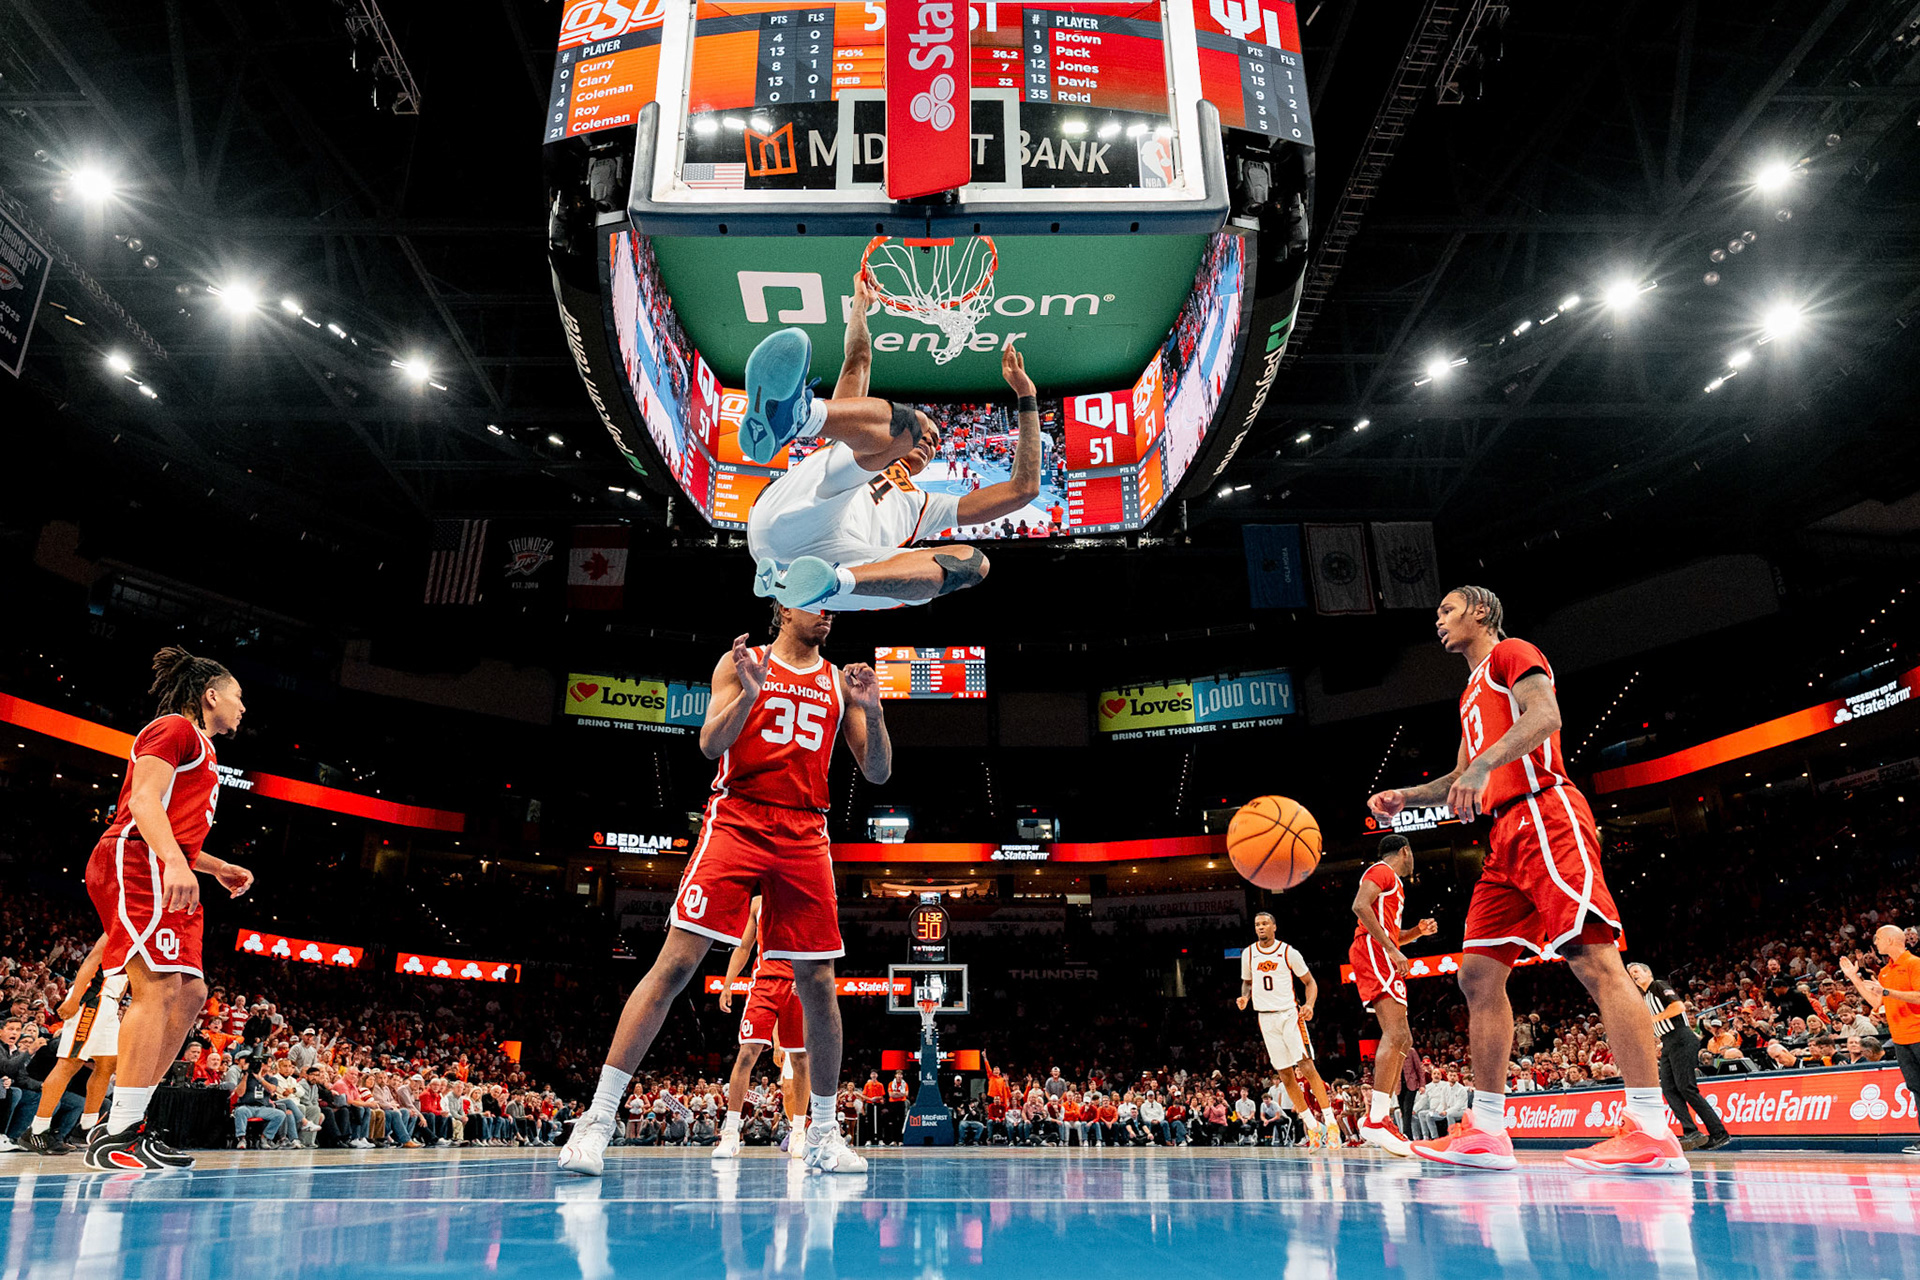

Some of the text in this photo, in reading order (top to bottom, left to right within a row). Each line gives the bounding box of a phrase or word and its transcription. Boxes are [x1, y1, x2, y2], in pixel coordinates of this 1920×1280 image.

[864, 0, 886, 31] 5
[562, 12, 825, 64] # PLAYER PTS FLS
[908, 0, 954, 70] Sta
[1032, 14, 1296, 66] # PLAYER PTS FLS
[560, 30, 820, 79] 0 Curry 4 0
[560, 45, 820, 93] 1 Clary 13 2
[836, 63, 1010, 72] TO 7
[837, 49, 1018, 60] FG% 36.2
[1033, 44, 1294, 94] 9 Pack 15 1
[1034, 30, 1292, 80] 1 Brown 10 1
[556, 60, 817, 108] 4 Coleman 8 1
[836, 76, 1014, 86] REB 32
[1030, 59, 1298, 109] 12 Jones 9 2
[550, 89, 816, 138] 21 Coleman 0 1
[554, 74, 818, 122] 9 Roy 13 0
[1030, 74, 1298, 123] 13 Davis 3 1
[1030, 90, 1302, 138] 35 Reid 5 0
[808, 130, 994, 167] MIDT
[1074, 392, 1129, 436] OU
[1090, 436, 1114, 465] 51
[718, 464, 737, 472] PLAYER
[507, 536, 555, 554] THUNDER
[896, 649, 910, 659] 51
[952, 649, 965, 659] 51
[762, 681, 833, 706] OKLAHOMA
[1198, 683, 1244, 718] LOUD
[1250, 682, 1290, 708] CITY
[1845, 680, 1898, 707] PRESENTED BY
[578, 718, 686, 735] BRING THE THUNDER
[761, 696, 828, 752] 35
[1112, 718, 1284, 742] BRING THE THUNDER EXIT NOW
[1378, 805, 1451, 829] EDLAM
[1394, 822, 1438, 834] BASKETBALL
[605, 832, 672, 850] BEDLAM
[618, 846, 658, 856] BASKETBALL
[682, 884, 708, 920] OU
[920, 912, 942, 922] 11:32
[156, 928, 180, 960] OU
[918, 922, 941, 940] 30
[1008, 968, 1099, 980] THUNDER
[1263, 976, 1274, 991] 0
